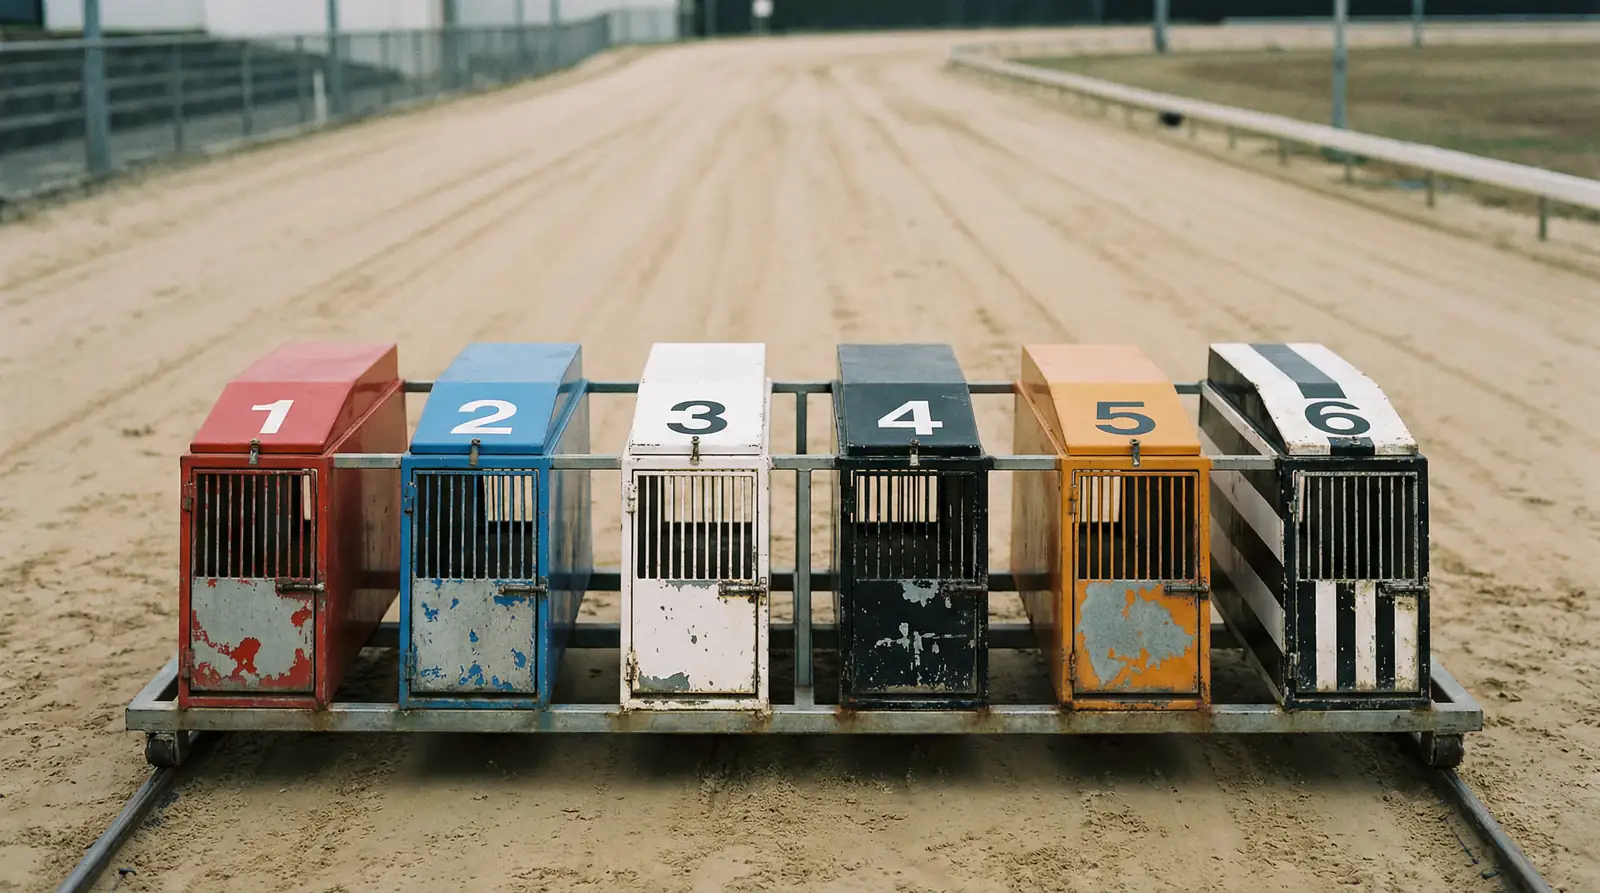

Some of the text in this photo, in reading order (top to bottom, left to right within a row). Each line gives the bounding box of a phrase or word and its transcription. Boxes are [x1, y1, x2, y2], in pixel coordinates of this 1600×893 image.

[251, 399, 294, 434] 1
[449, 399, 518, 435] 2
[665, 400, 728, 435] 3
[877, 400, 943, 436] 4
[1095, 401, 1156, 436] 5
[1304, 400, 1371, 436] 6
